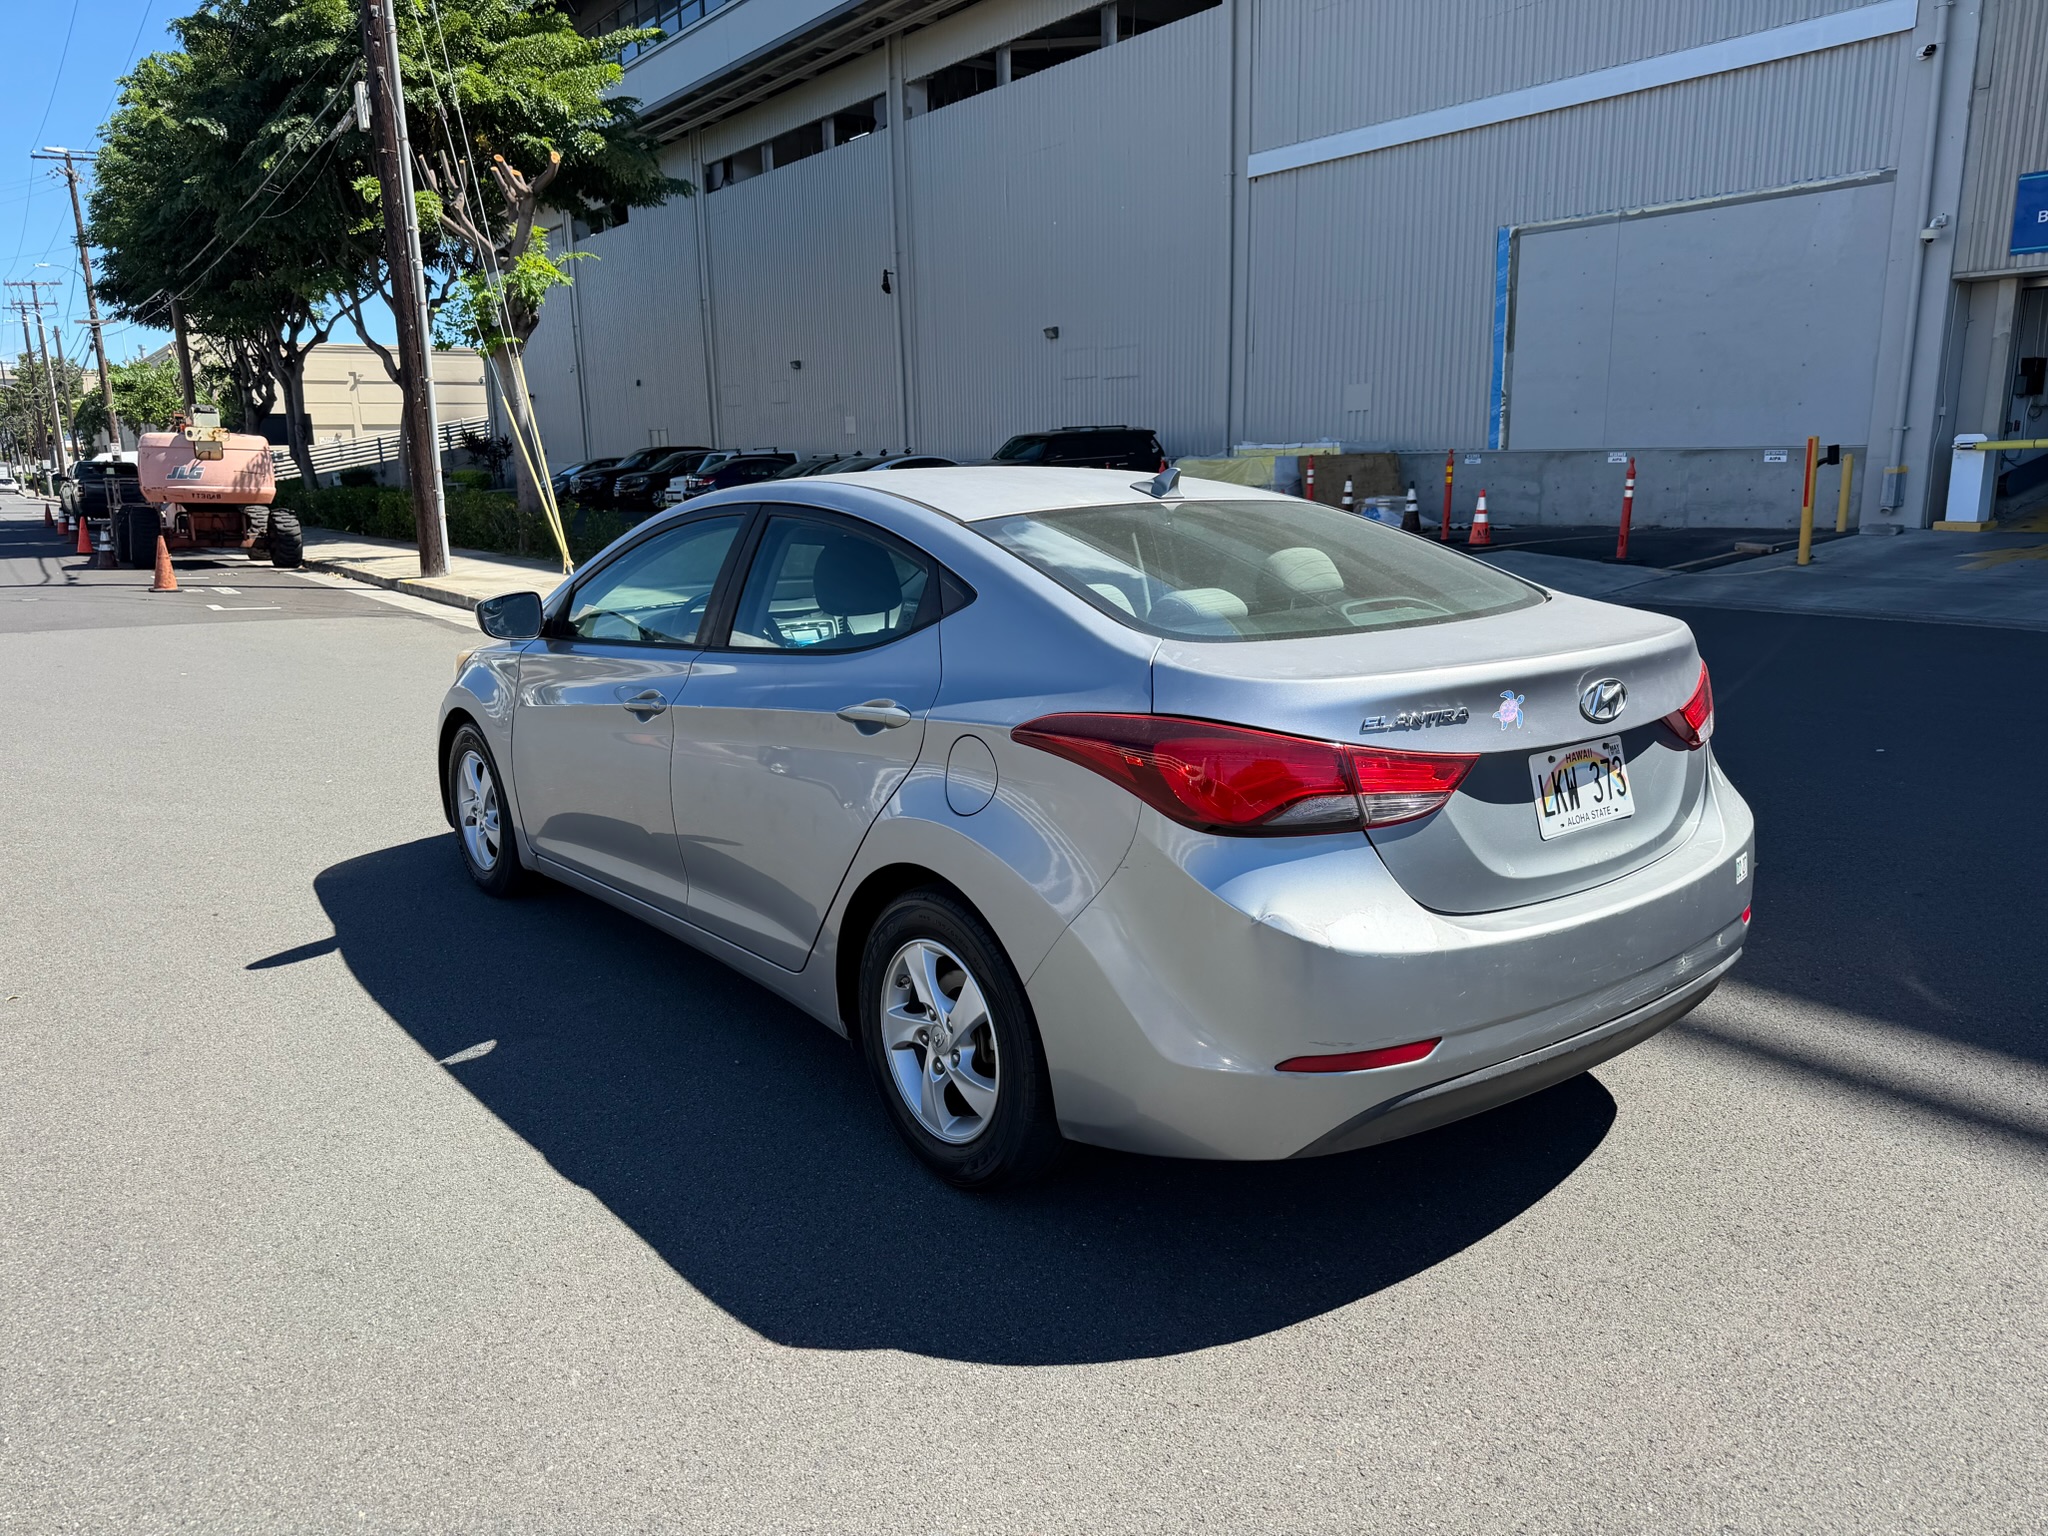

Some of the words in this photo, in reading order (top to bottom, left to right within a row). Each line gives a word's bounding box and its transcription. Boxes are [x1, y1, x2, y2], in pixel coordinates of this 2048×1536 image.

[166, 466, 205, 480] JLG
[1362, 706, 1470, 731] ELANTRA
[1565, 748, 1593, 763] HAWAII
[1537, 766, 1580, 818] LKW
[1589, 756, 1627, 803] 373
[1567, 813, 1590, 826] ALOHA
[1590, 806, 1612, 820] STATE
